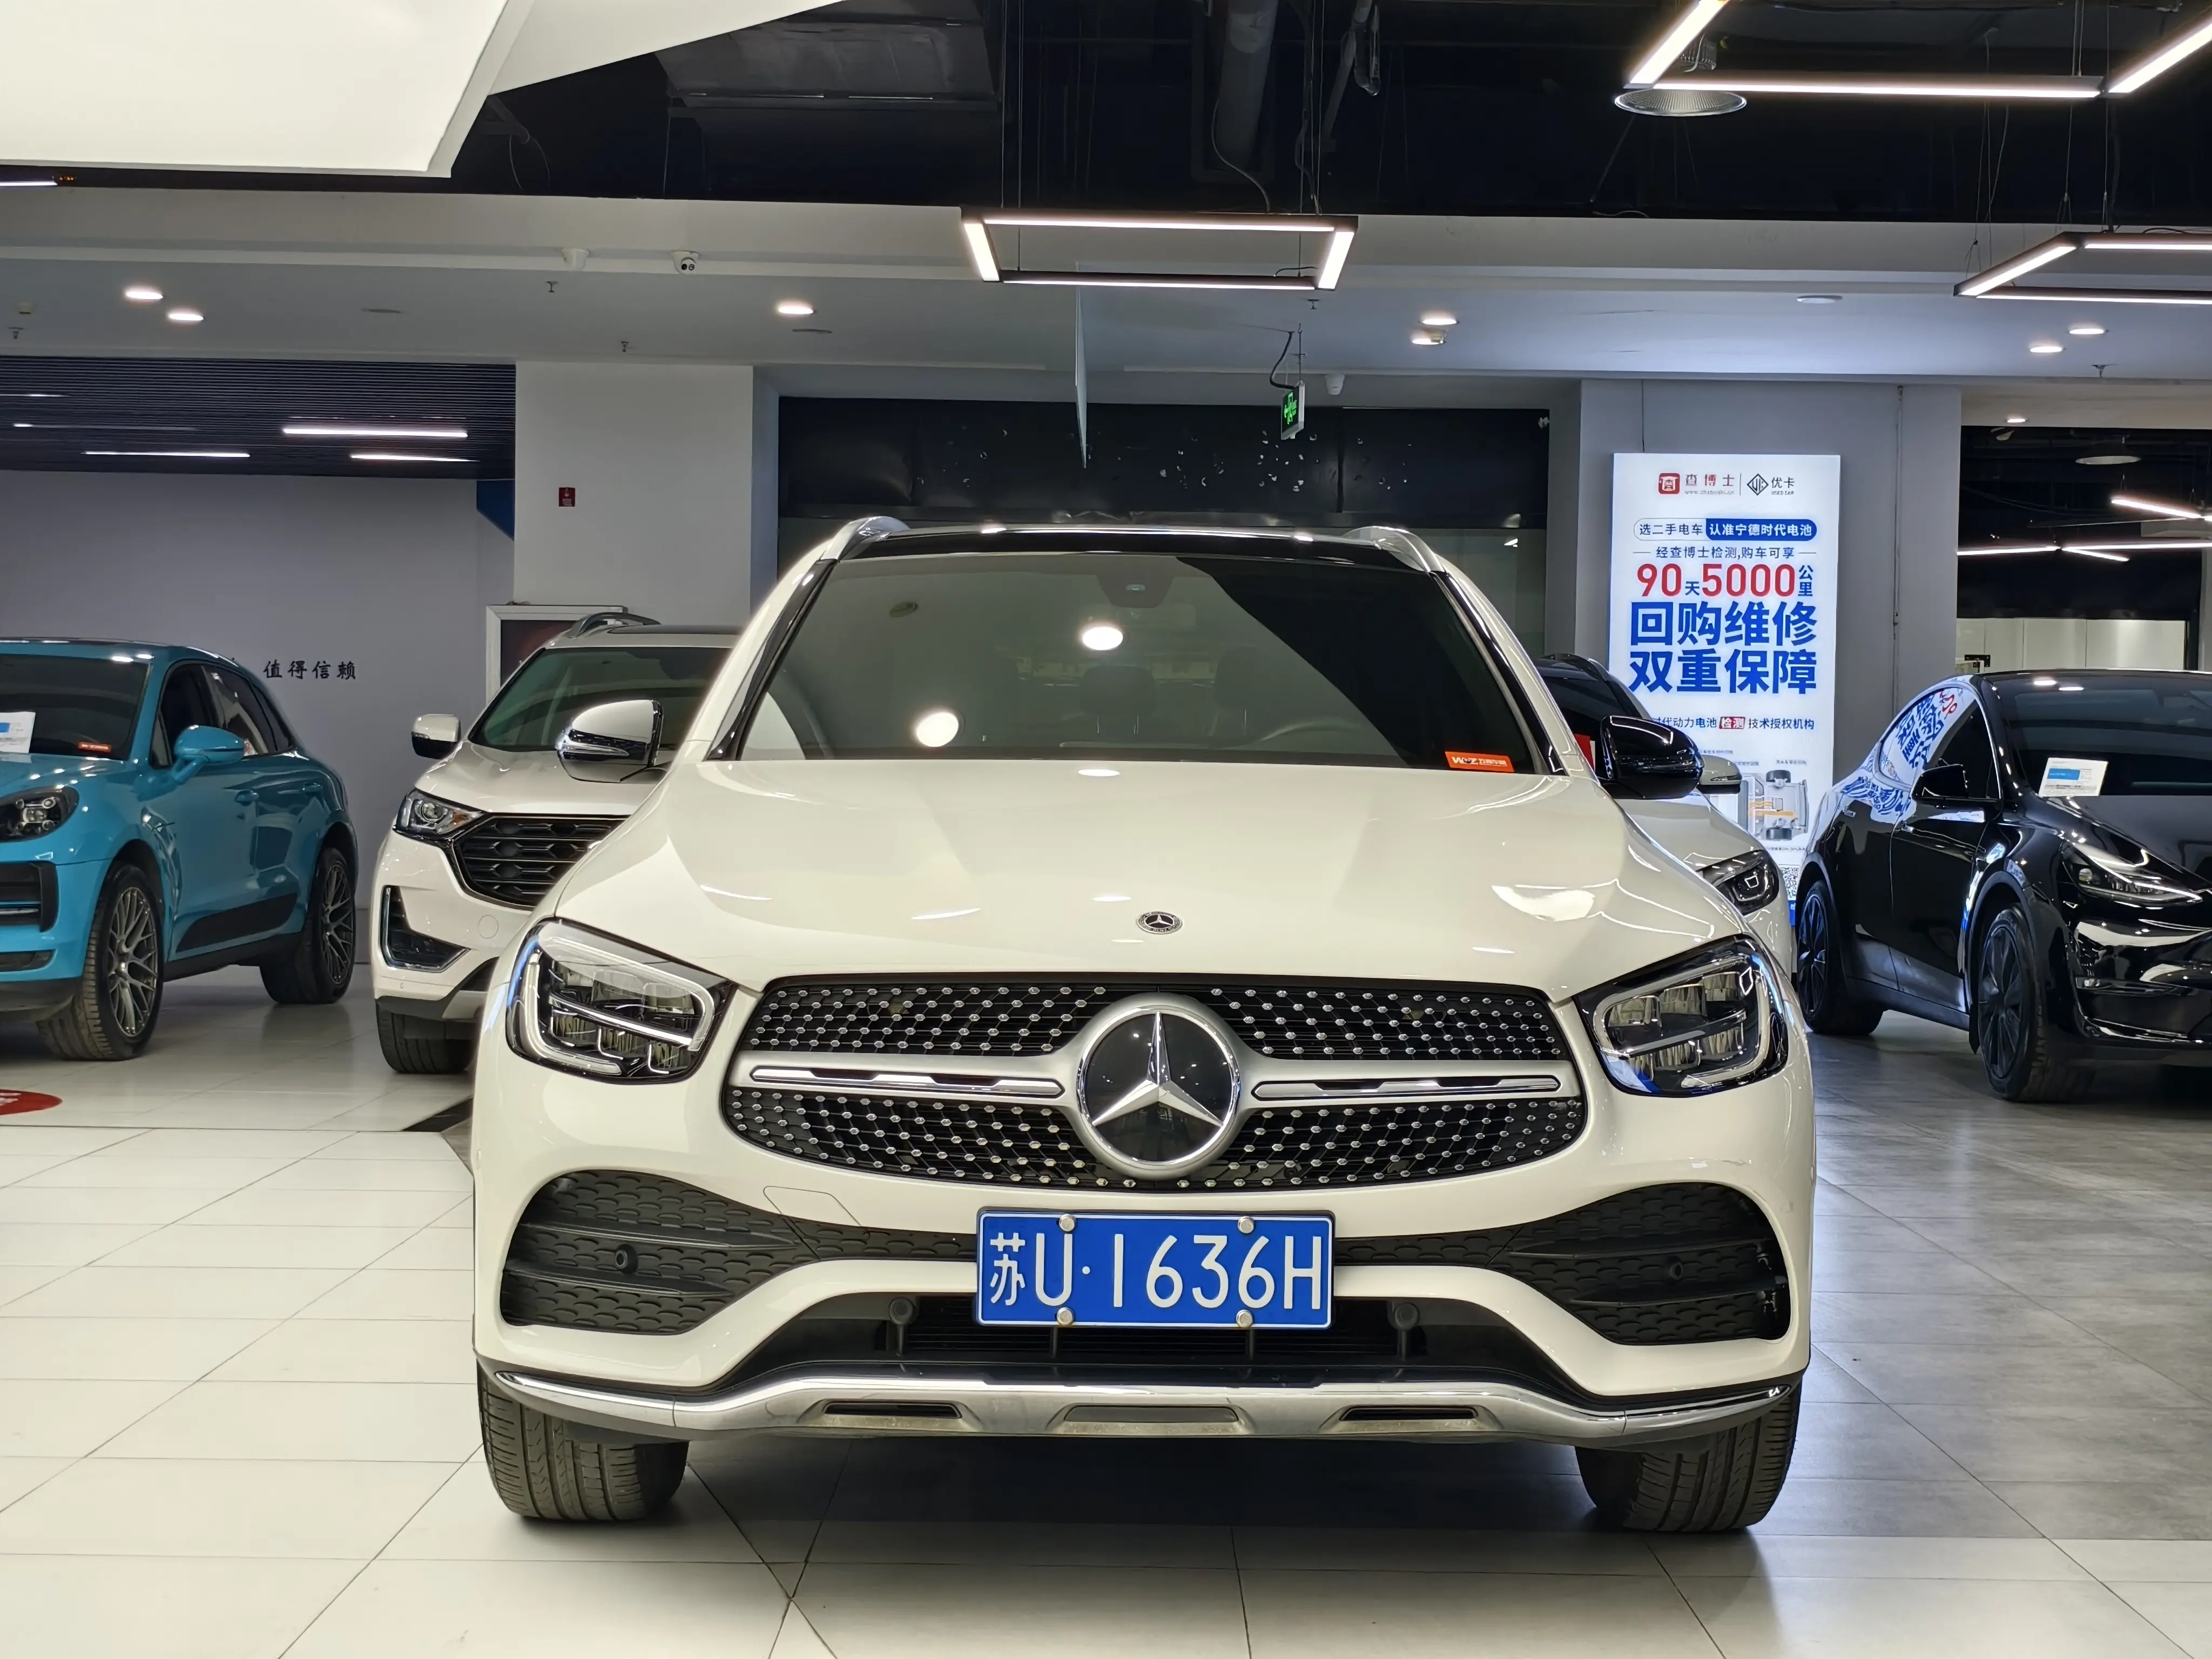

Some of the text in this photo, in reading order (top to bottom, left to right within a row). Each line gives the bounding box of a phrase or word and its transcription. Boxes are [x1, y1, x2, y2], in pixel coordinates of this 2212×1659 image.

[1771, 476, 1795, 489] 优卡
[1639, 523, 1812, 537] 选二手电车 认准宁德时代电池
[1630, 601, 1818, 647] 回购维修
[262, 659, 356, 680] 值得信赖
[1628, 648, 1817, 695] 双重保障
[1748, 718, 1815, 730] 技术授权机构
[989, 1232, 1322, 1310] 苏U·1636H
